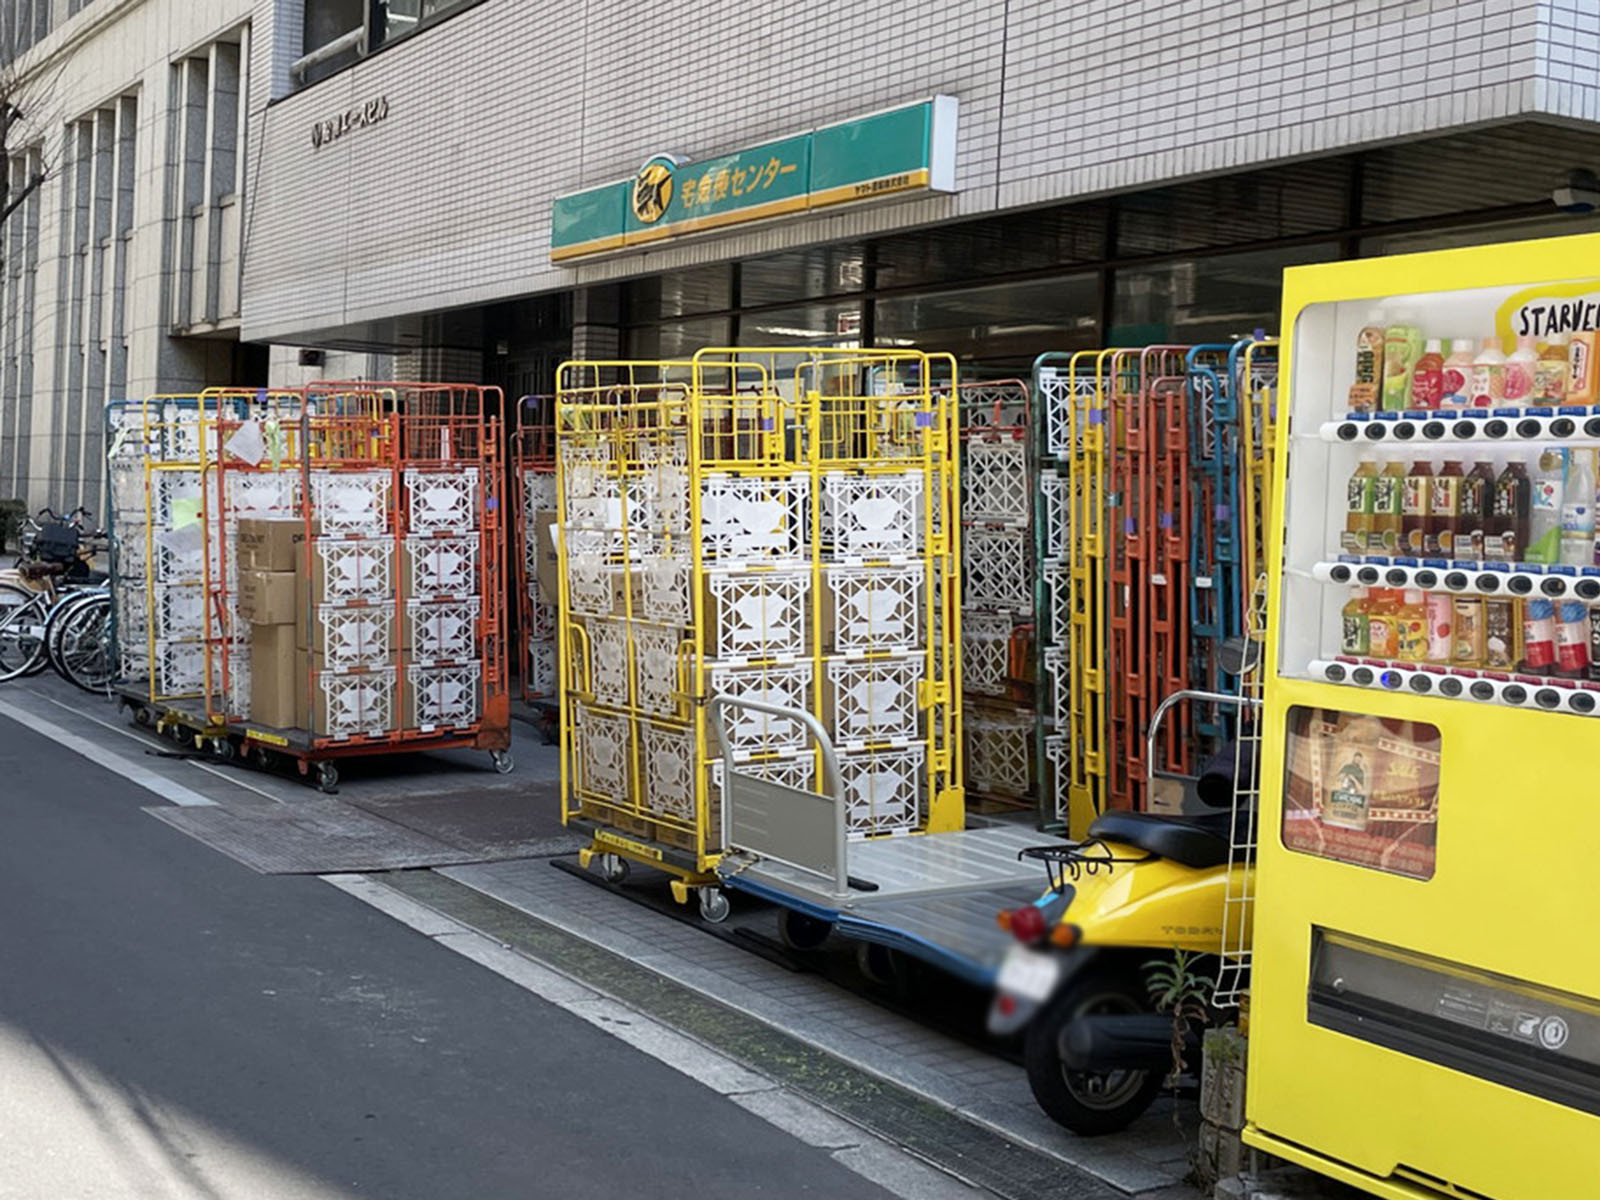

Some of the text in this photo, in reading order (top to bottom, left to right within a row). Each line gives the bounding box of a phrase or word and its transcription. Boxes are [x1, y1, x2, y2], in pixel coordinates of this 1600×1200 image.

[681, 157, 797, 208] 宅急便センター
[1520, 299, 1600, 337] STARVE
